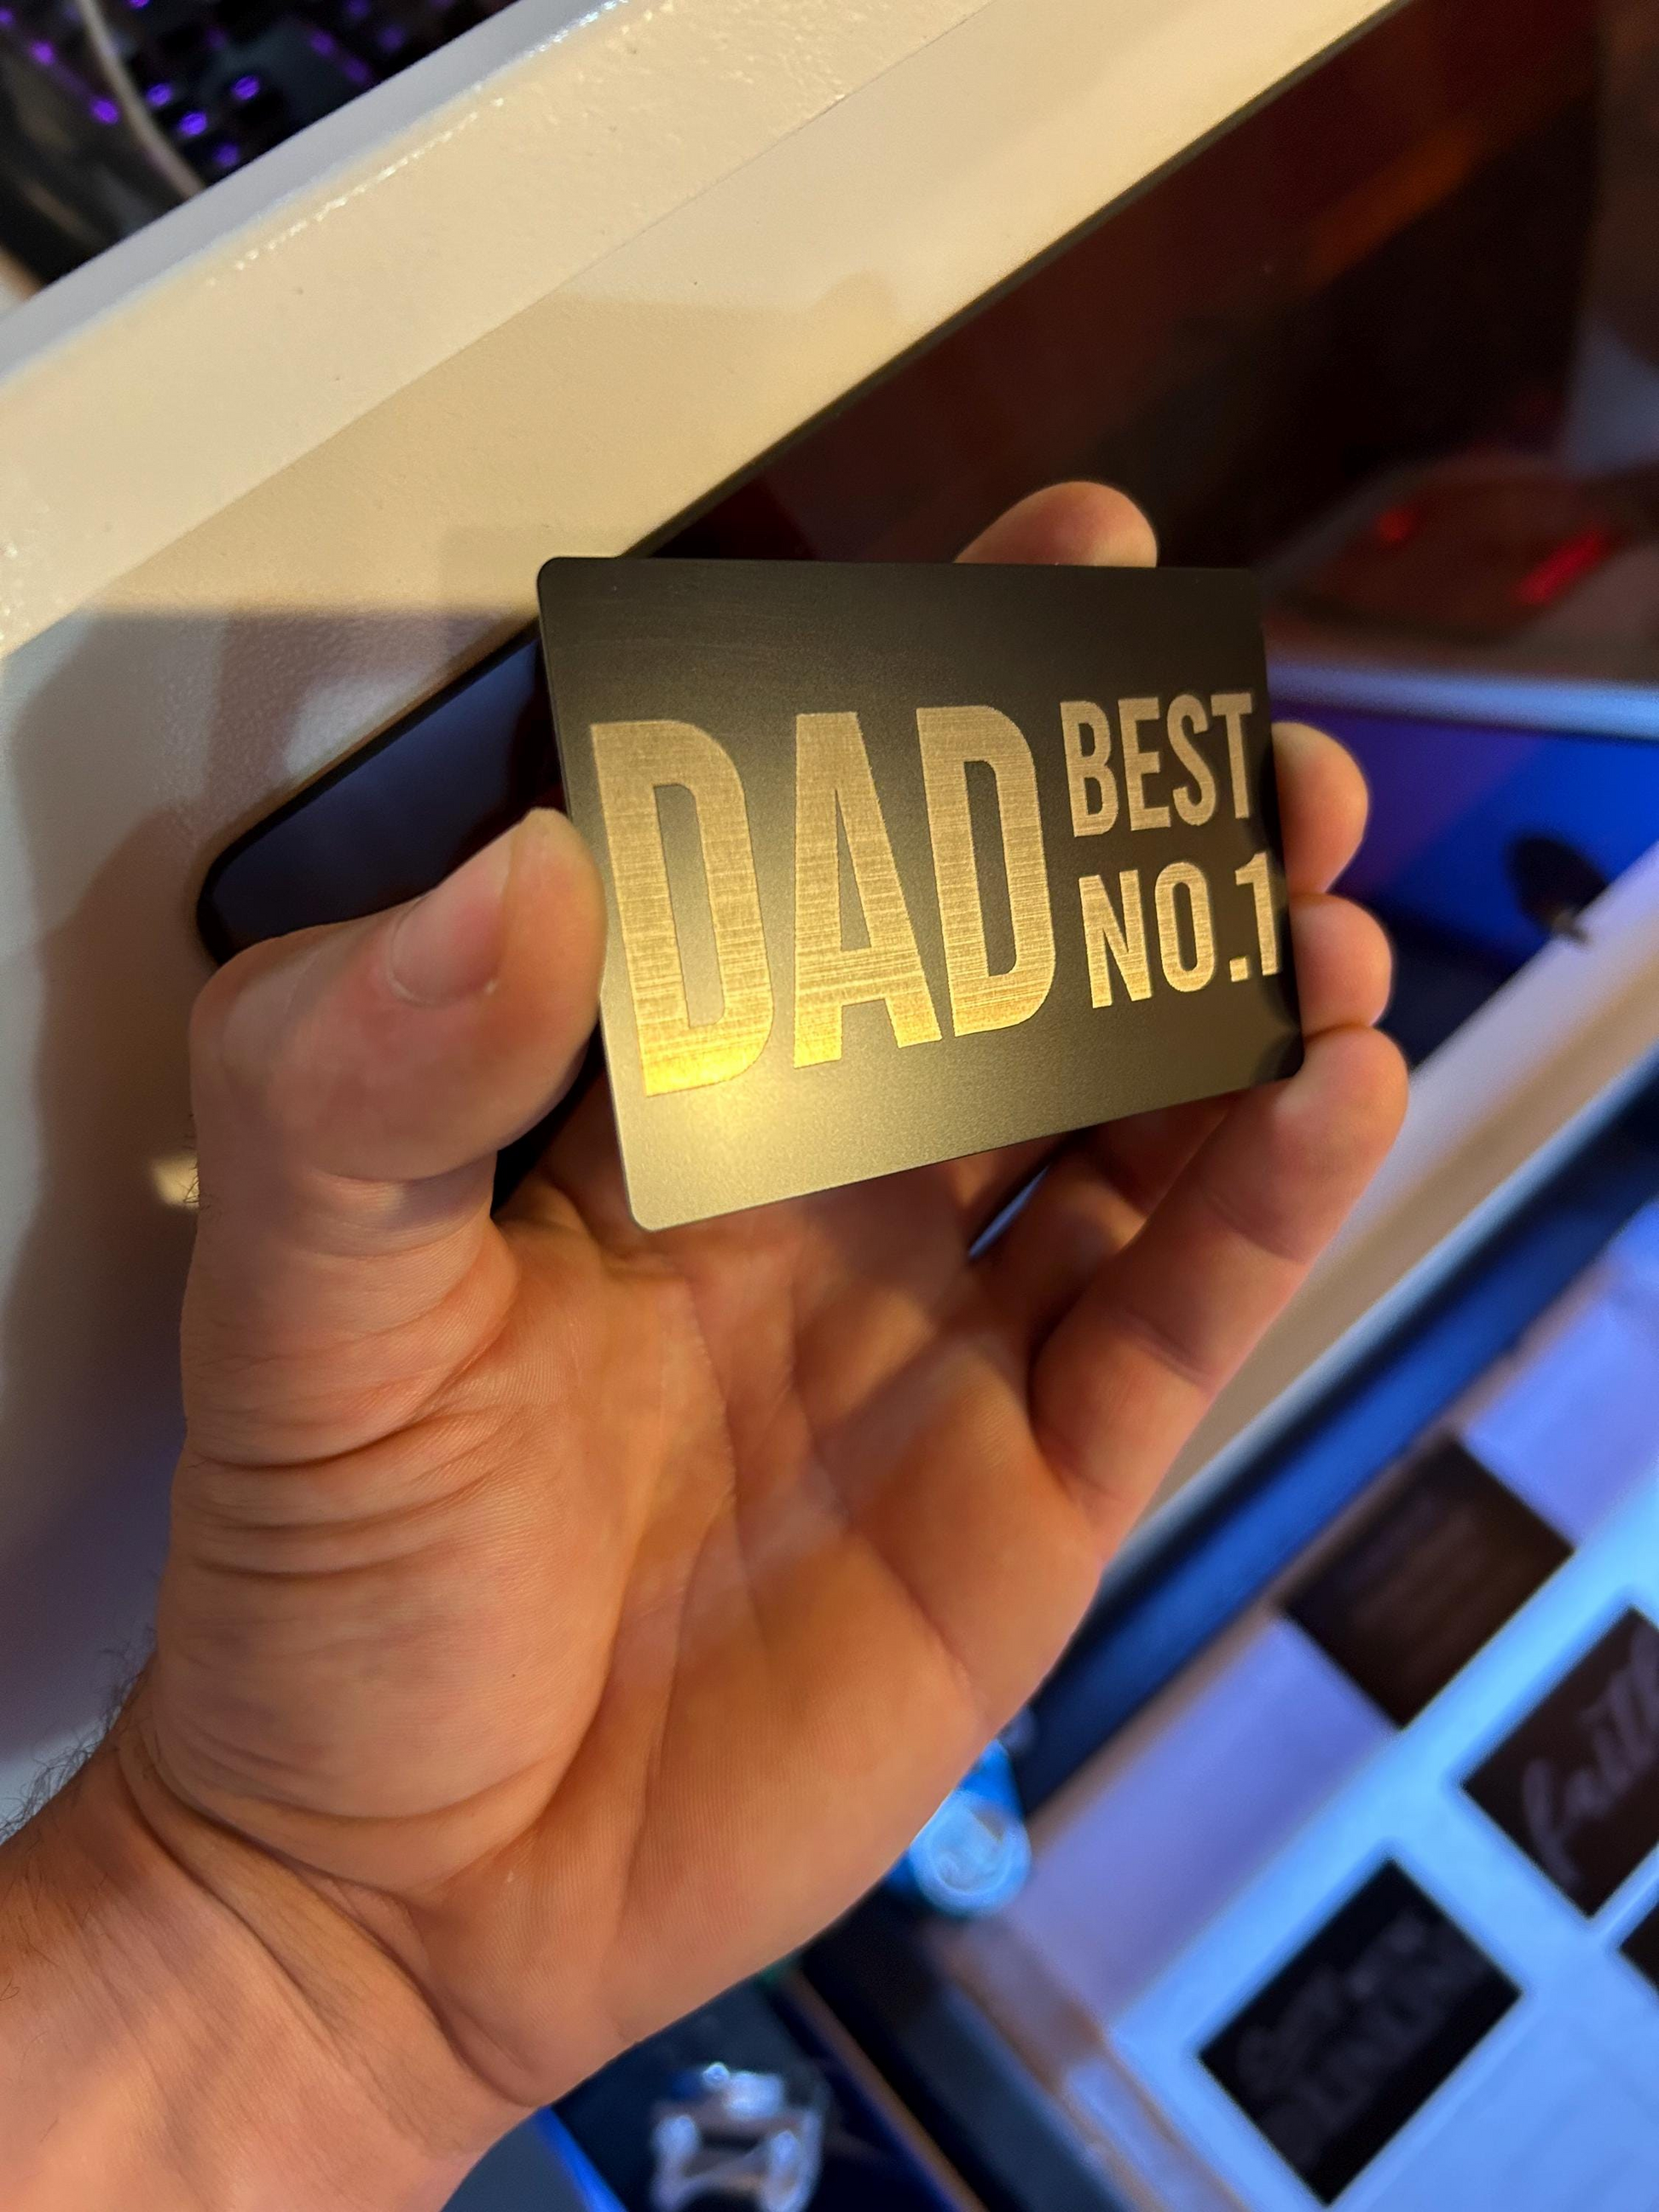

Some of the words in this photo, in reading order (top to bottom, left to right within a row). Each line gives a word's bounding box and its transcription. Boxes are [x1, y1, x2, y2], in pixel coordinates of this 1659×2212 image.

[1061, 692, 1253, 836] BEST
[591, 706, 1055, 1095] DAD
[1079, 852, 1280, 1008] NO.1
